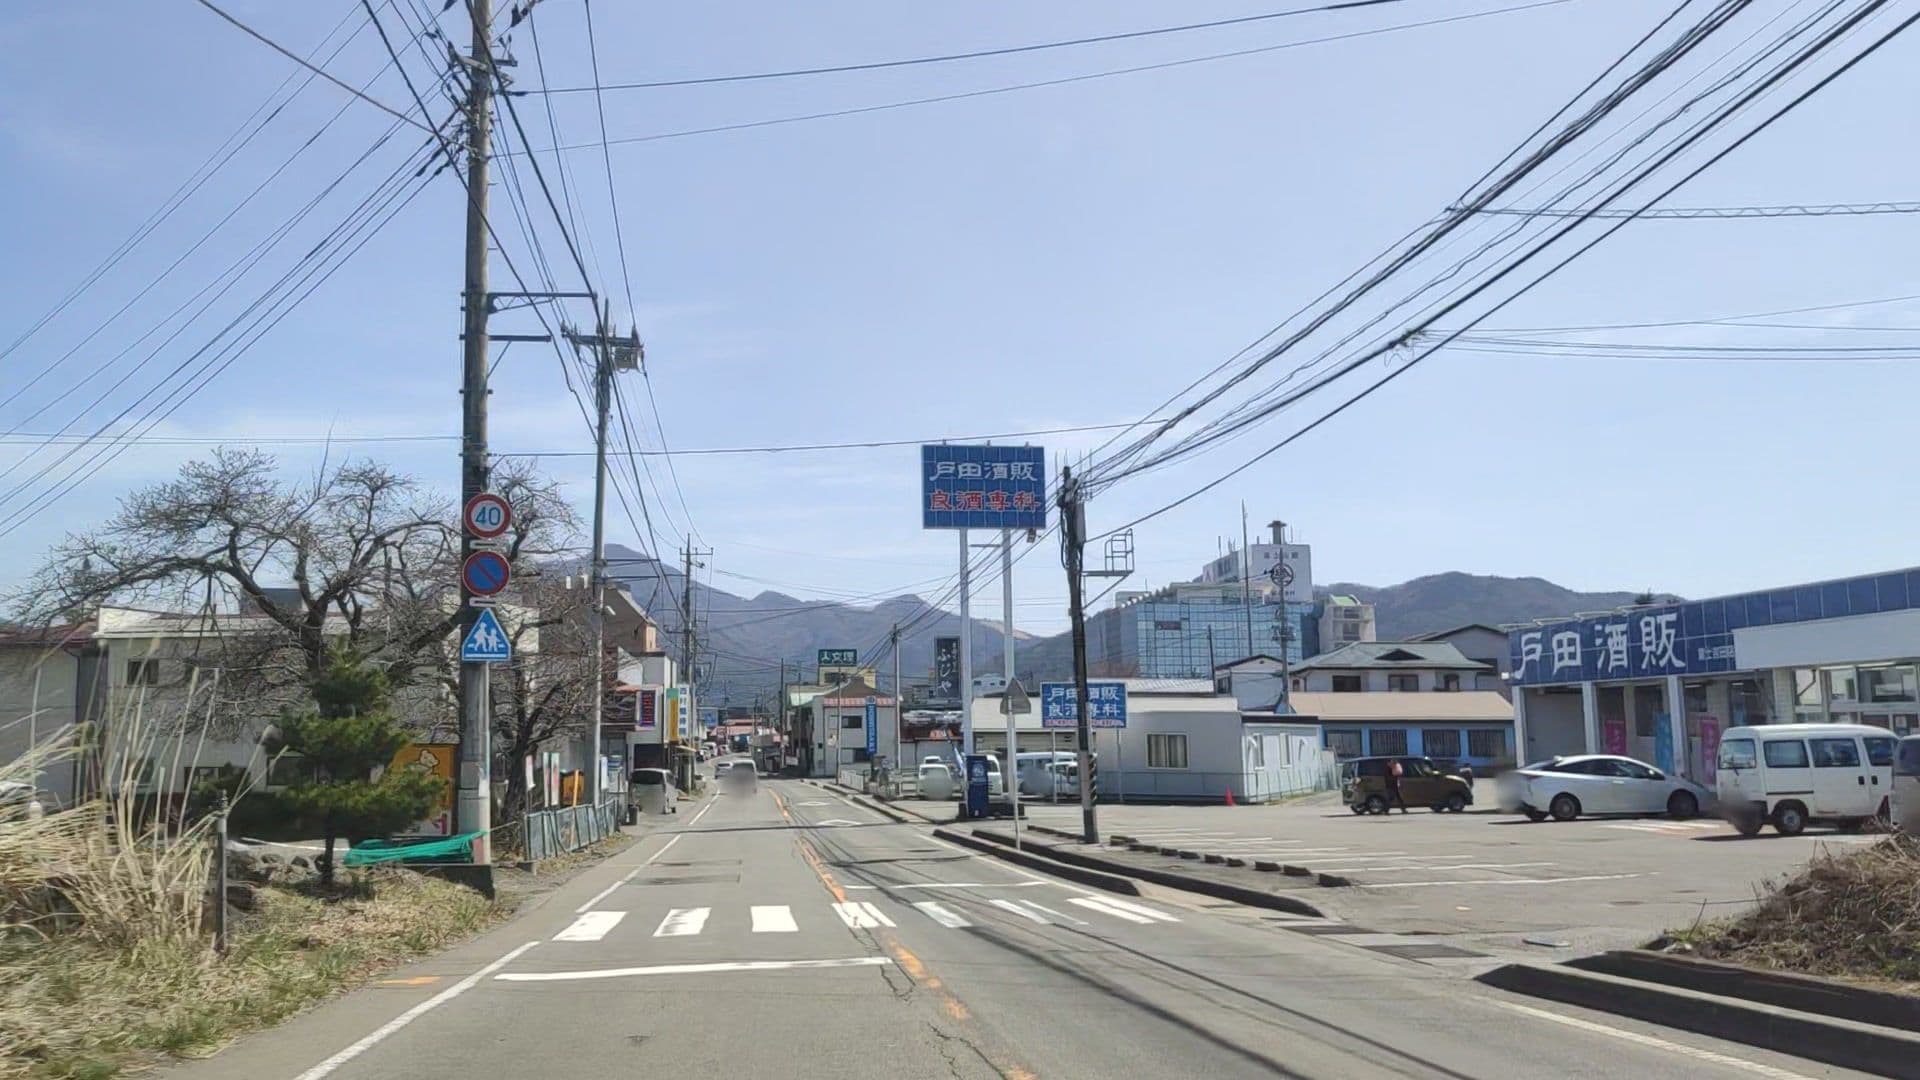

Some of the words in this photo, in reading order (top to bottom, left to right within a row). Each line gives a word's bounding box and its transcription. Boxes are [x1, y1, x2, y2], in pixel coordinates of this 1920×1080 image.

[929, 461, 1038, 482] 戸田酒販
[930, 489, 1041, 512] 良酒専科
[475, 506, 501, 526] 40
[1514, 613, 1686, 680] 戸田酒販
